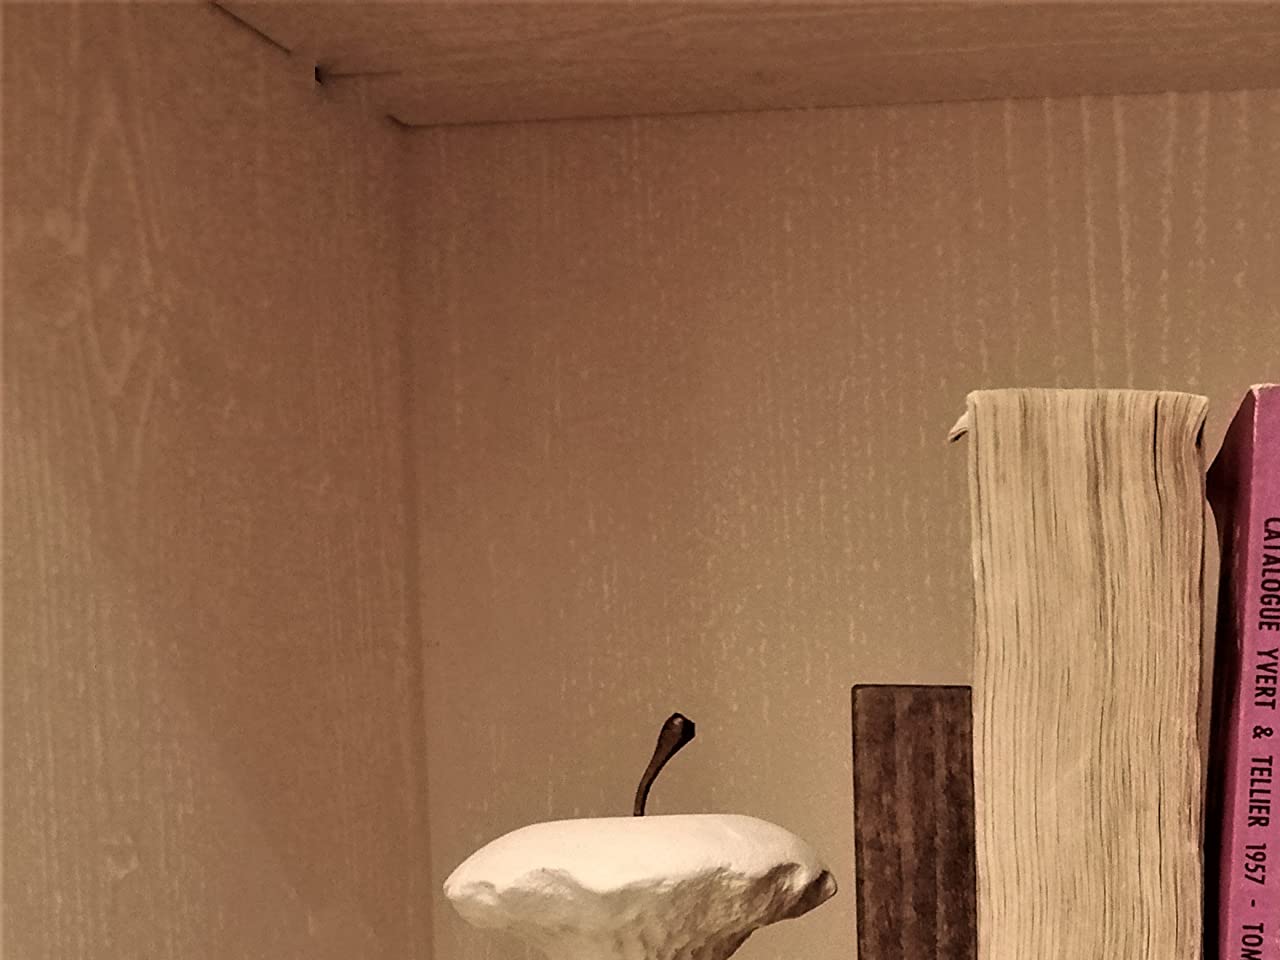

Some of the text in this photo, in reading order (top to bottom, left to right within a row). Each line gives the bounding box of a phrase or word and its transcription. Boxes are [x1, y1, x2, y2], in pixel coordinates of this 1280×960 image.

[1254, 648, 1279, 710] YVERT
[1253, 726, 1273, 739] &
[1248, 755, 1273, 827] TELLIER
[1245, 843, 1266, 885] 1957
